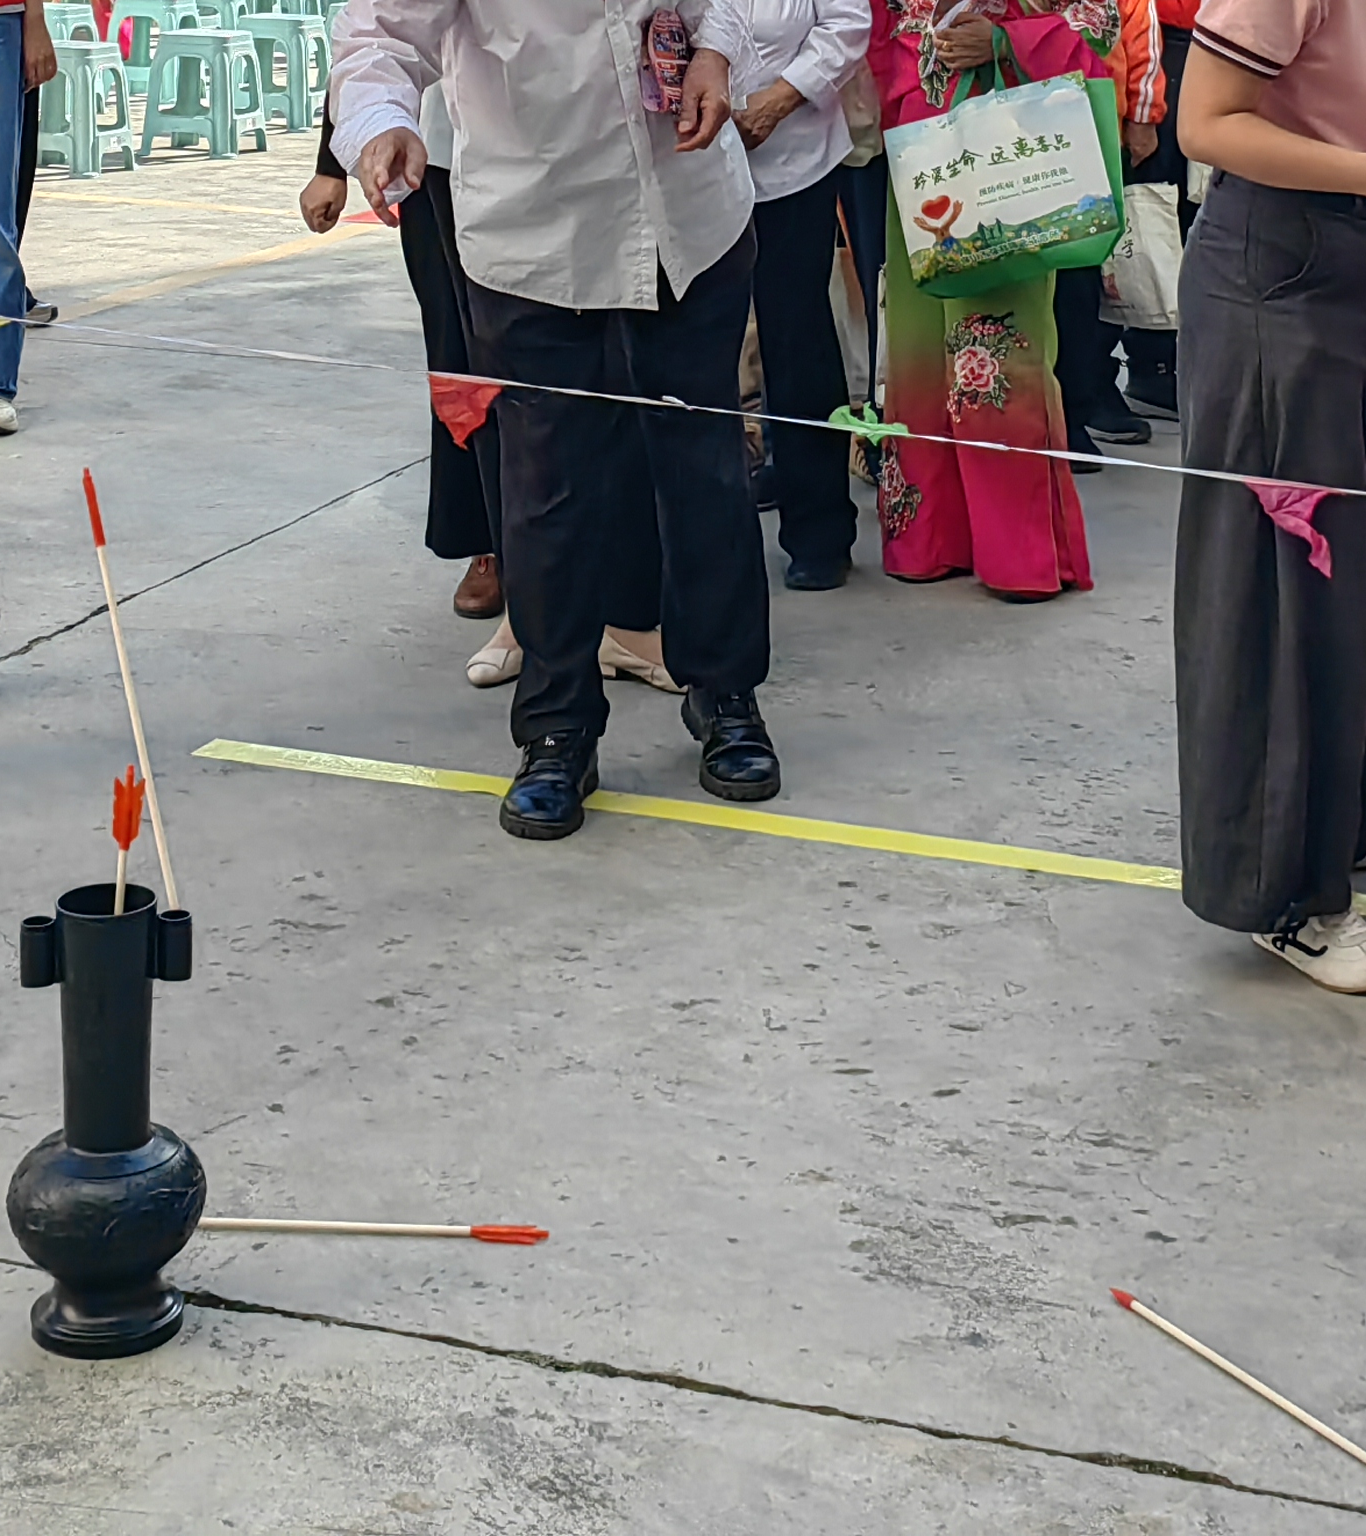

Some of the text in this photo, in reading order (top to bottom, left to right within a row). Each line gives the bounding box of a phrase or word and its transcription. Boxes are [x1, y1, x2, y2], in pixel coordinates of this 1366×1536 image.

[912, 133, 1072, 191] 珍爱生命 远离毒品
